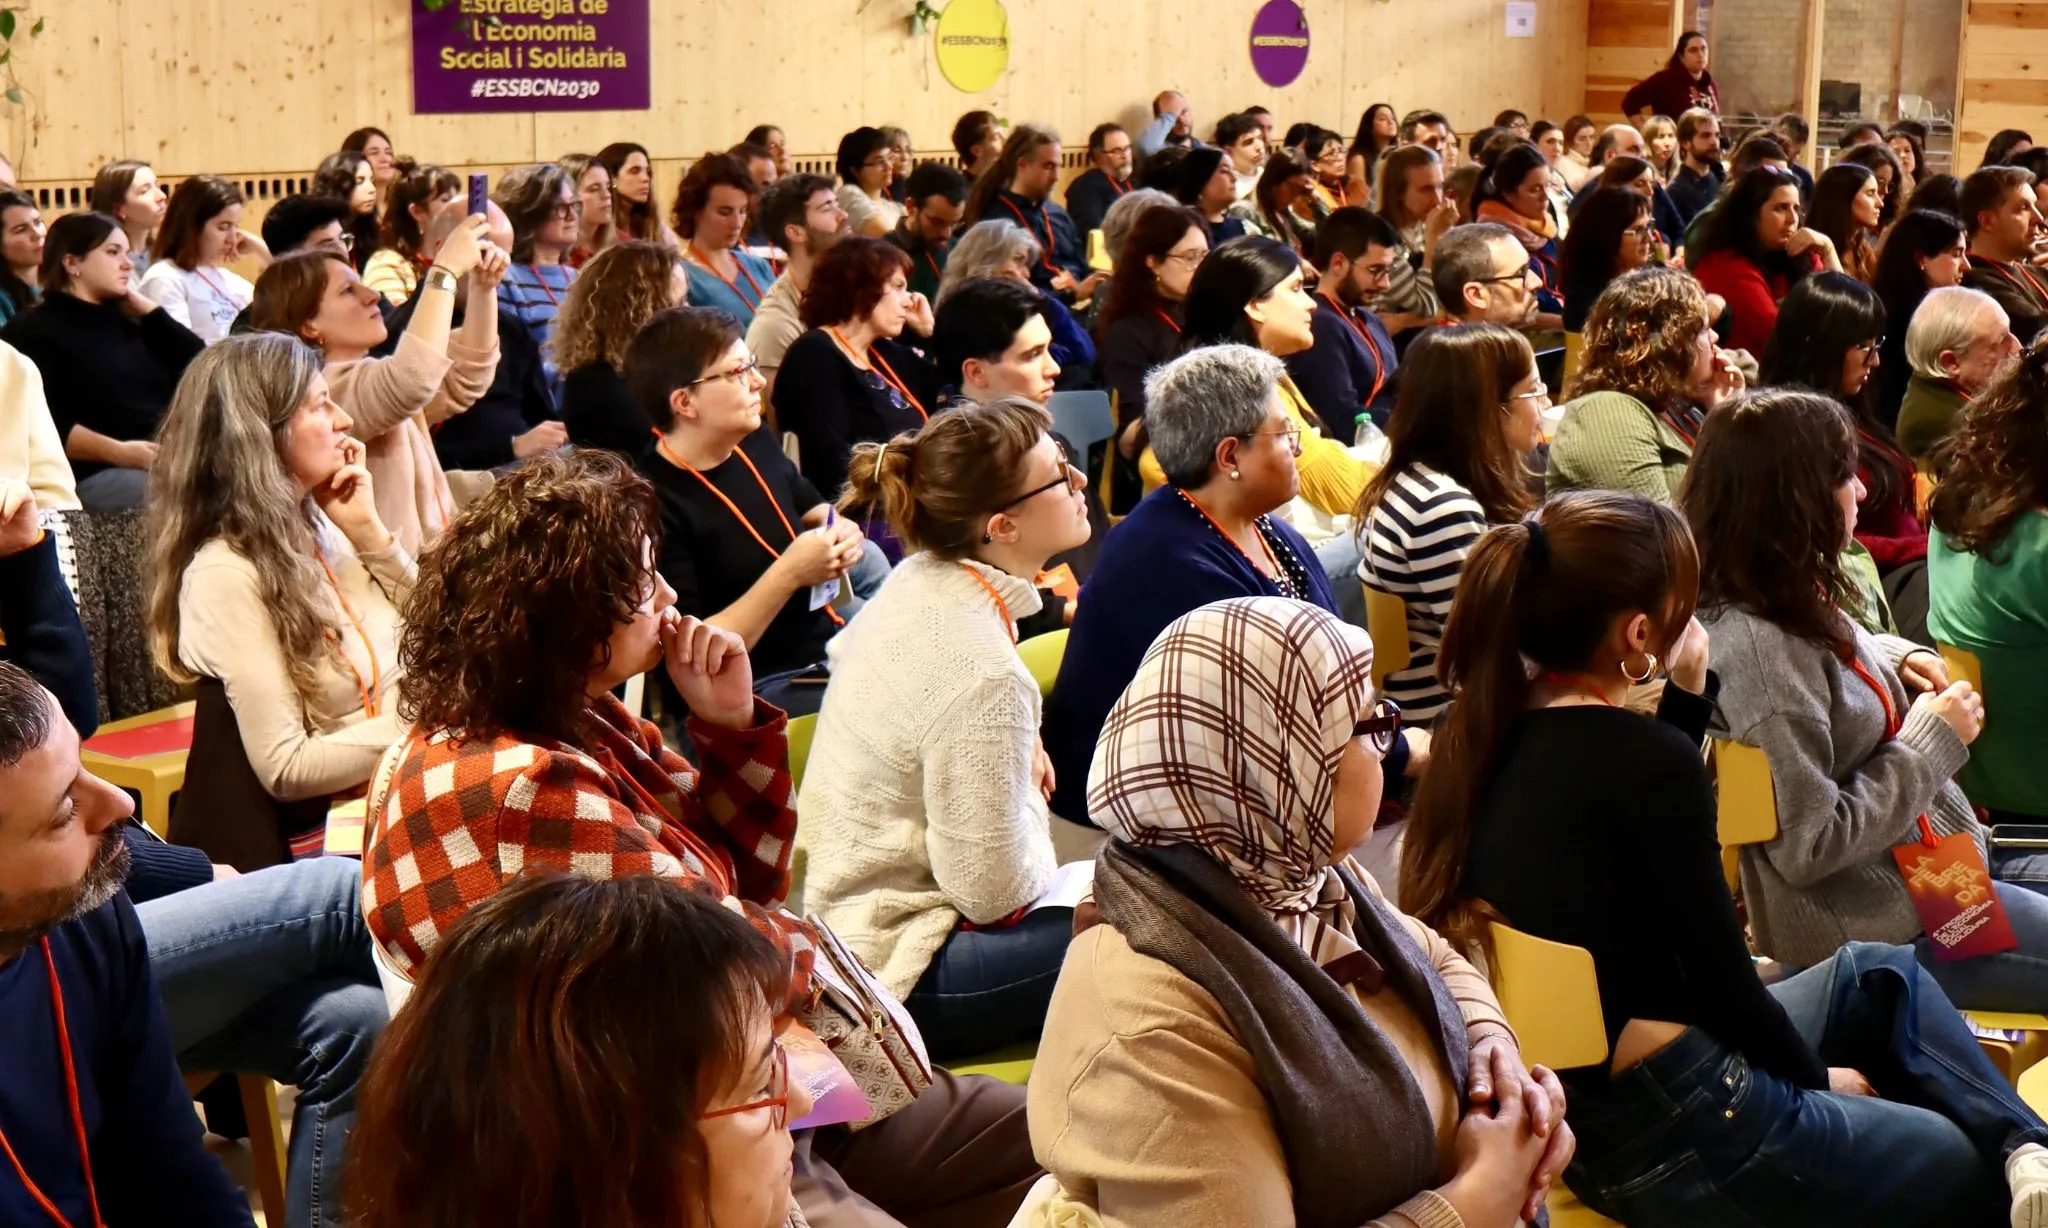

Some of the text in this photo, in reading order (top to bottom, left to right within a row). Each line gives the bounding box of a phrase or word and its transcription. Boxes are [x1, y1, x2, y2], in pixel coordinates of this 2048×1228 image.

[441, 46, 627, 69] Social i Solidària
[471, 78, 600, 99] #ESSBCN2030
